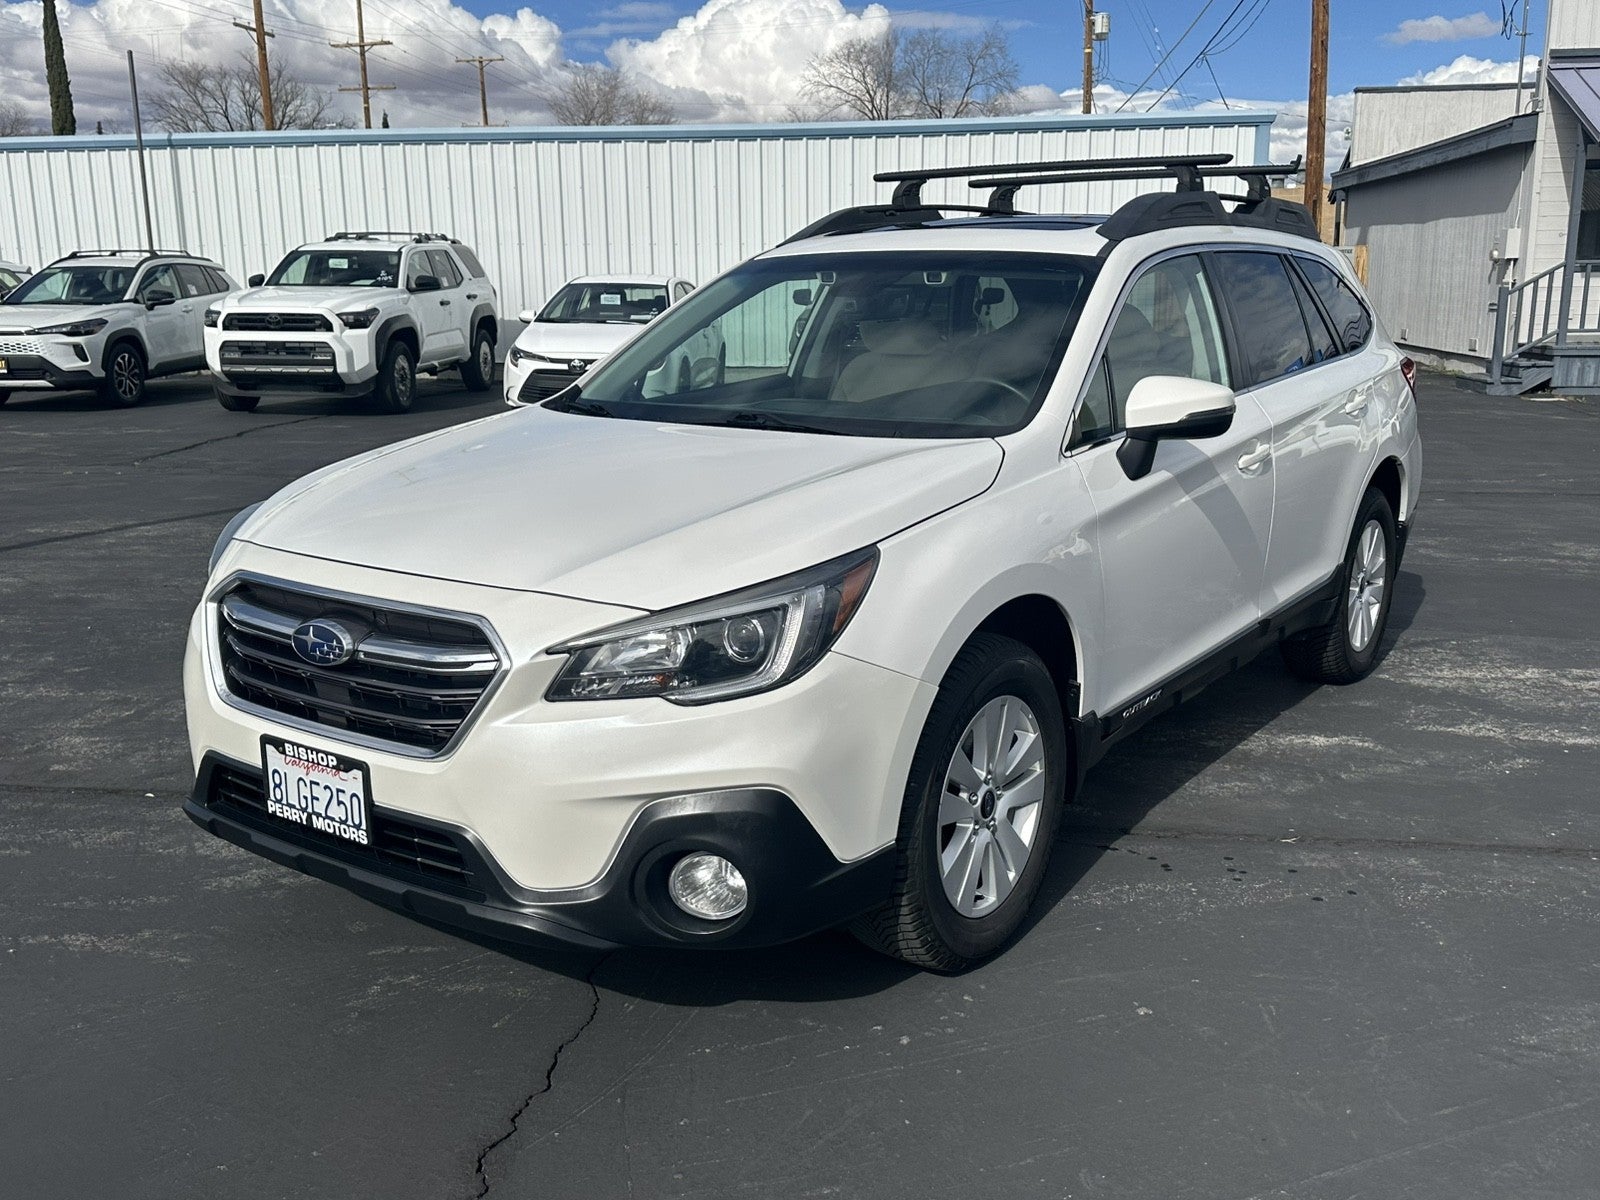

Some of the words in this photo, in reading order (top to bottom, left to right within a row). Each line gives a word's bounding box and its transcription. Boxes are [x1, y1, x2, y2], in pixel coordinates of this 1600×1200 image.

[284, 743, 338, 768] BISHOP
[272, 768, 363, 829] 8LGE250
[267, 800, 308, 825] PERRY
[311, 814, 368, 845] MOTORS
